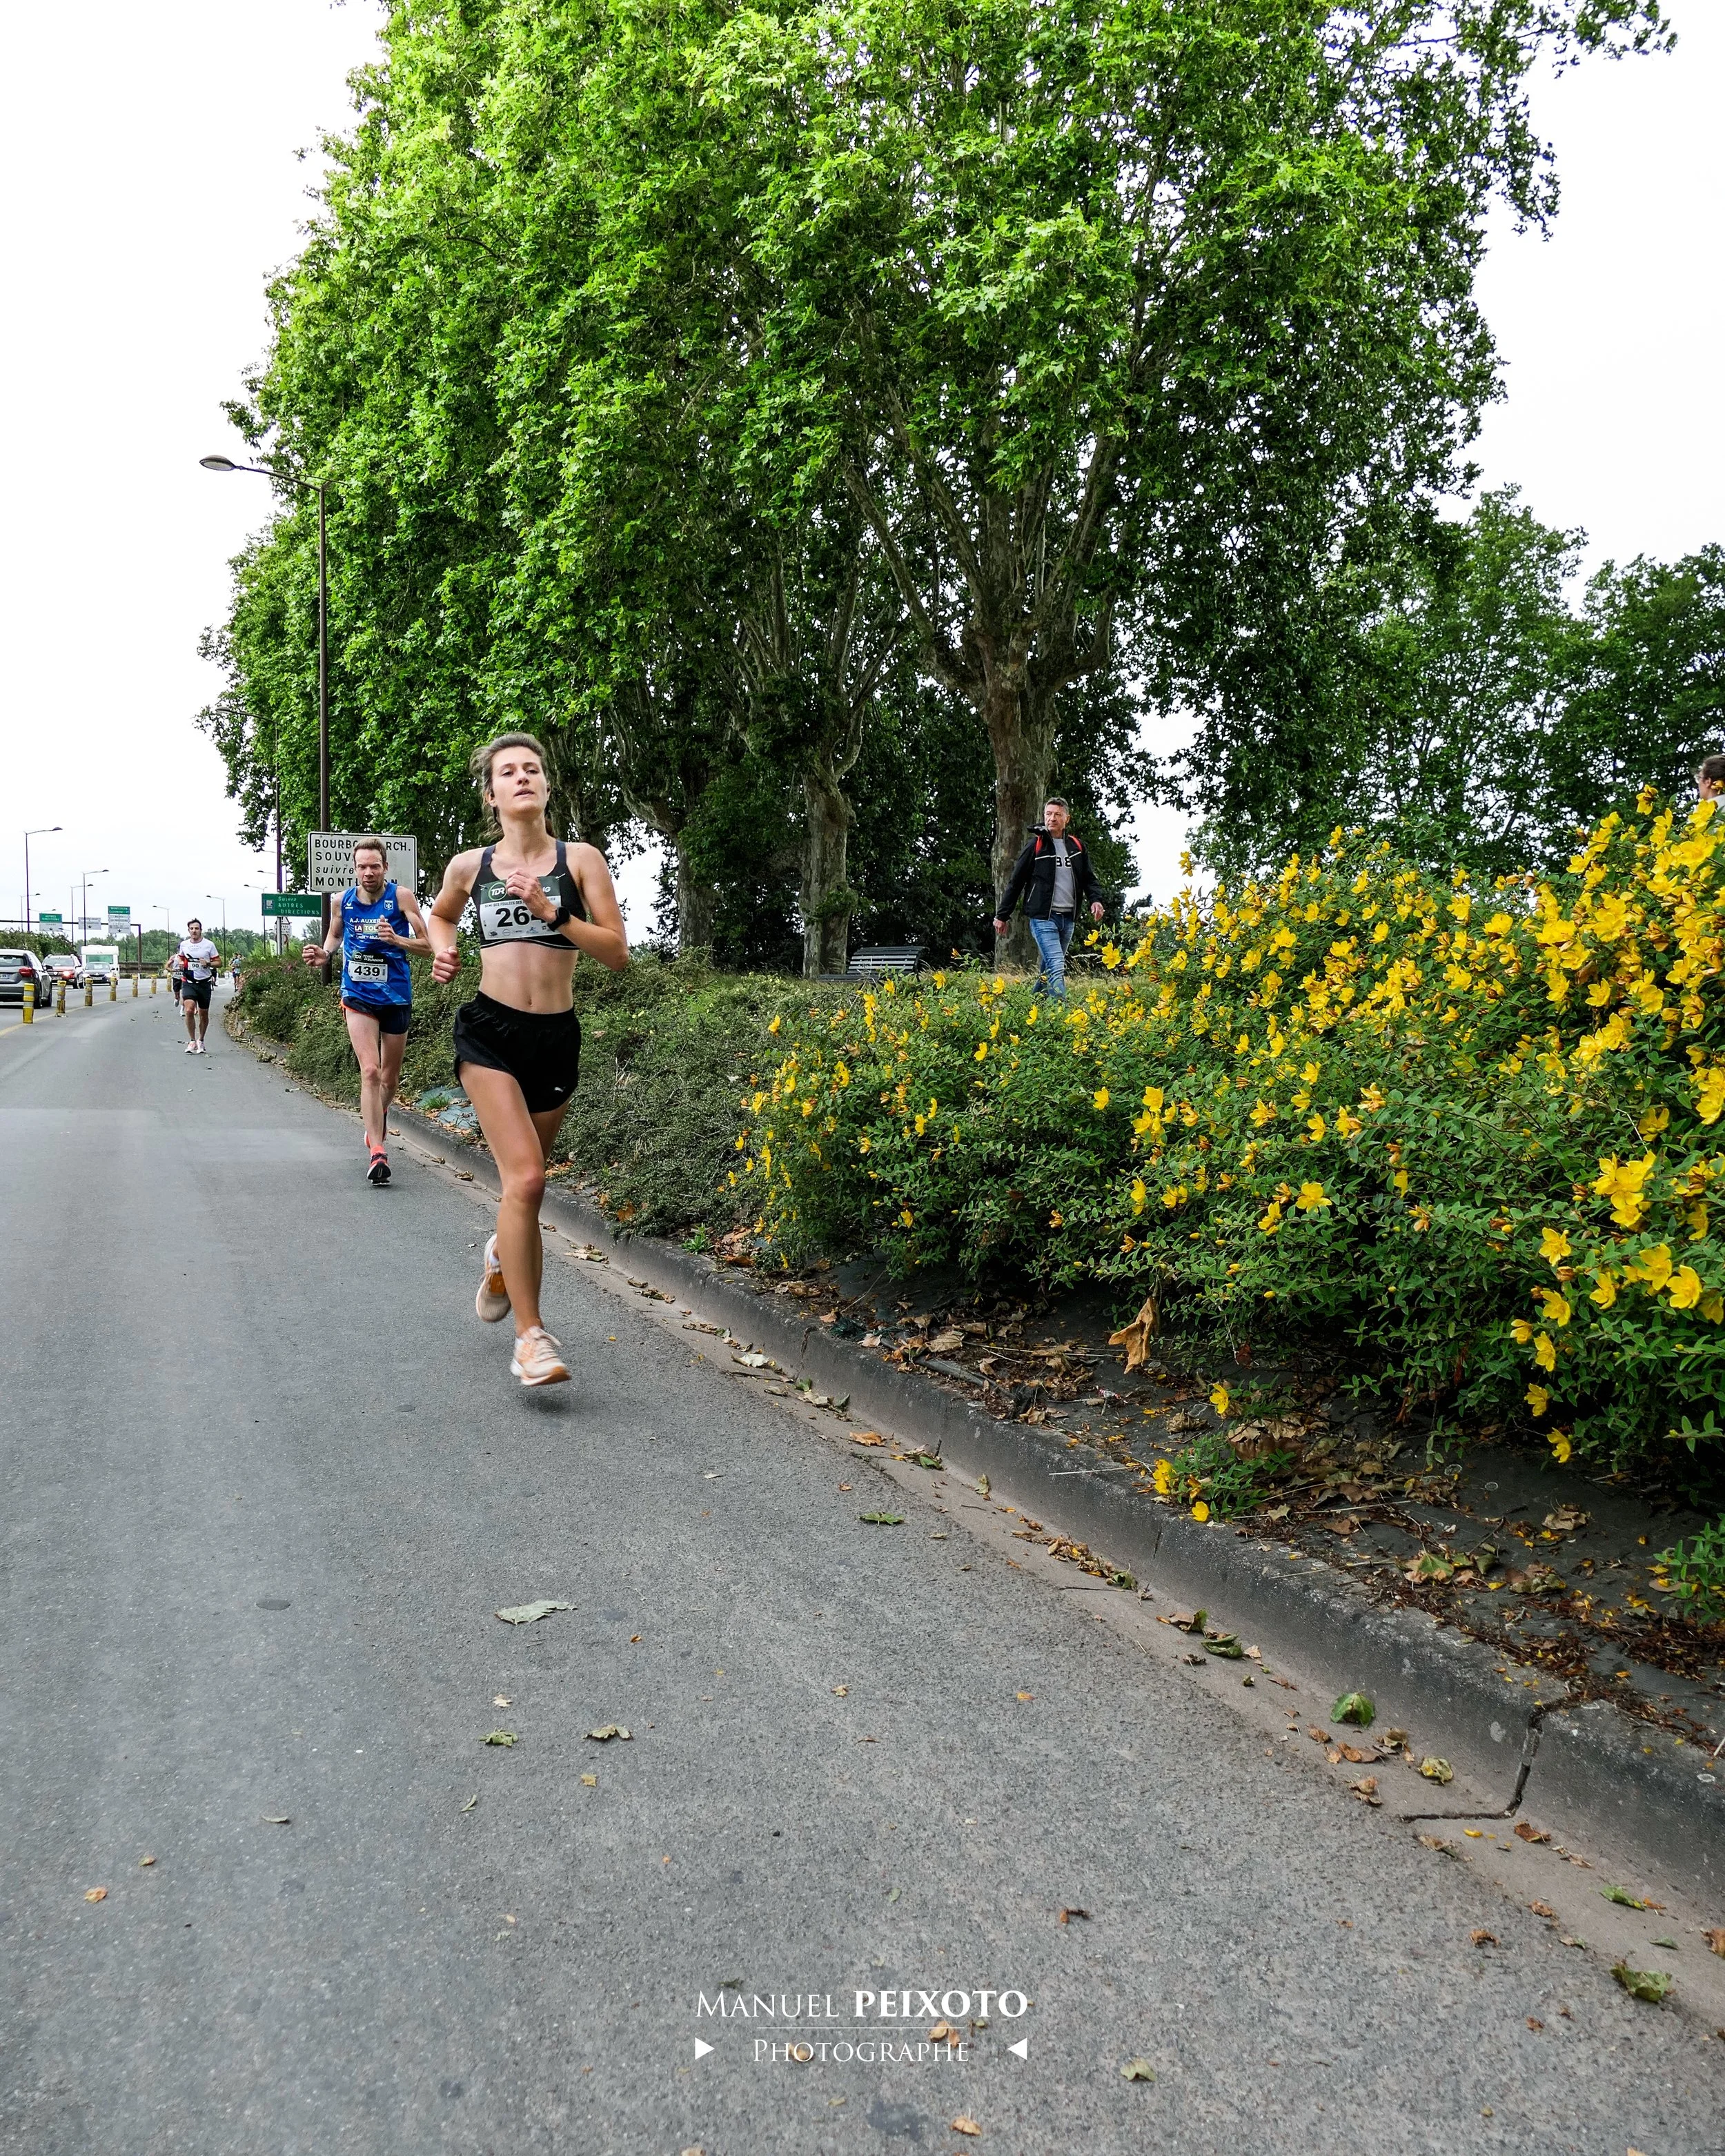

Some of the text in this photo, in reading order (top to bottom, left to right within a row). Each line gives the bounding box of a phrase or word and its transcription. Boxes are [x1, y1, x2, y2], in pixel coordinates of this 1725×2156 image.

[315, 851, 353, 862] SOUV
[315, 864, 354, 874] suivre
[491, 887, 505, 896] TDR
[354, 965, 380, 976] 439
